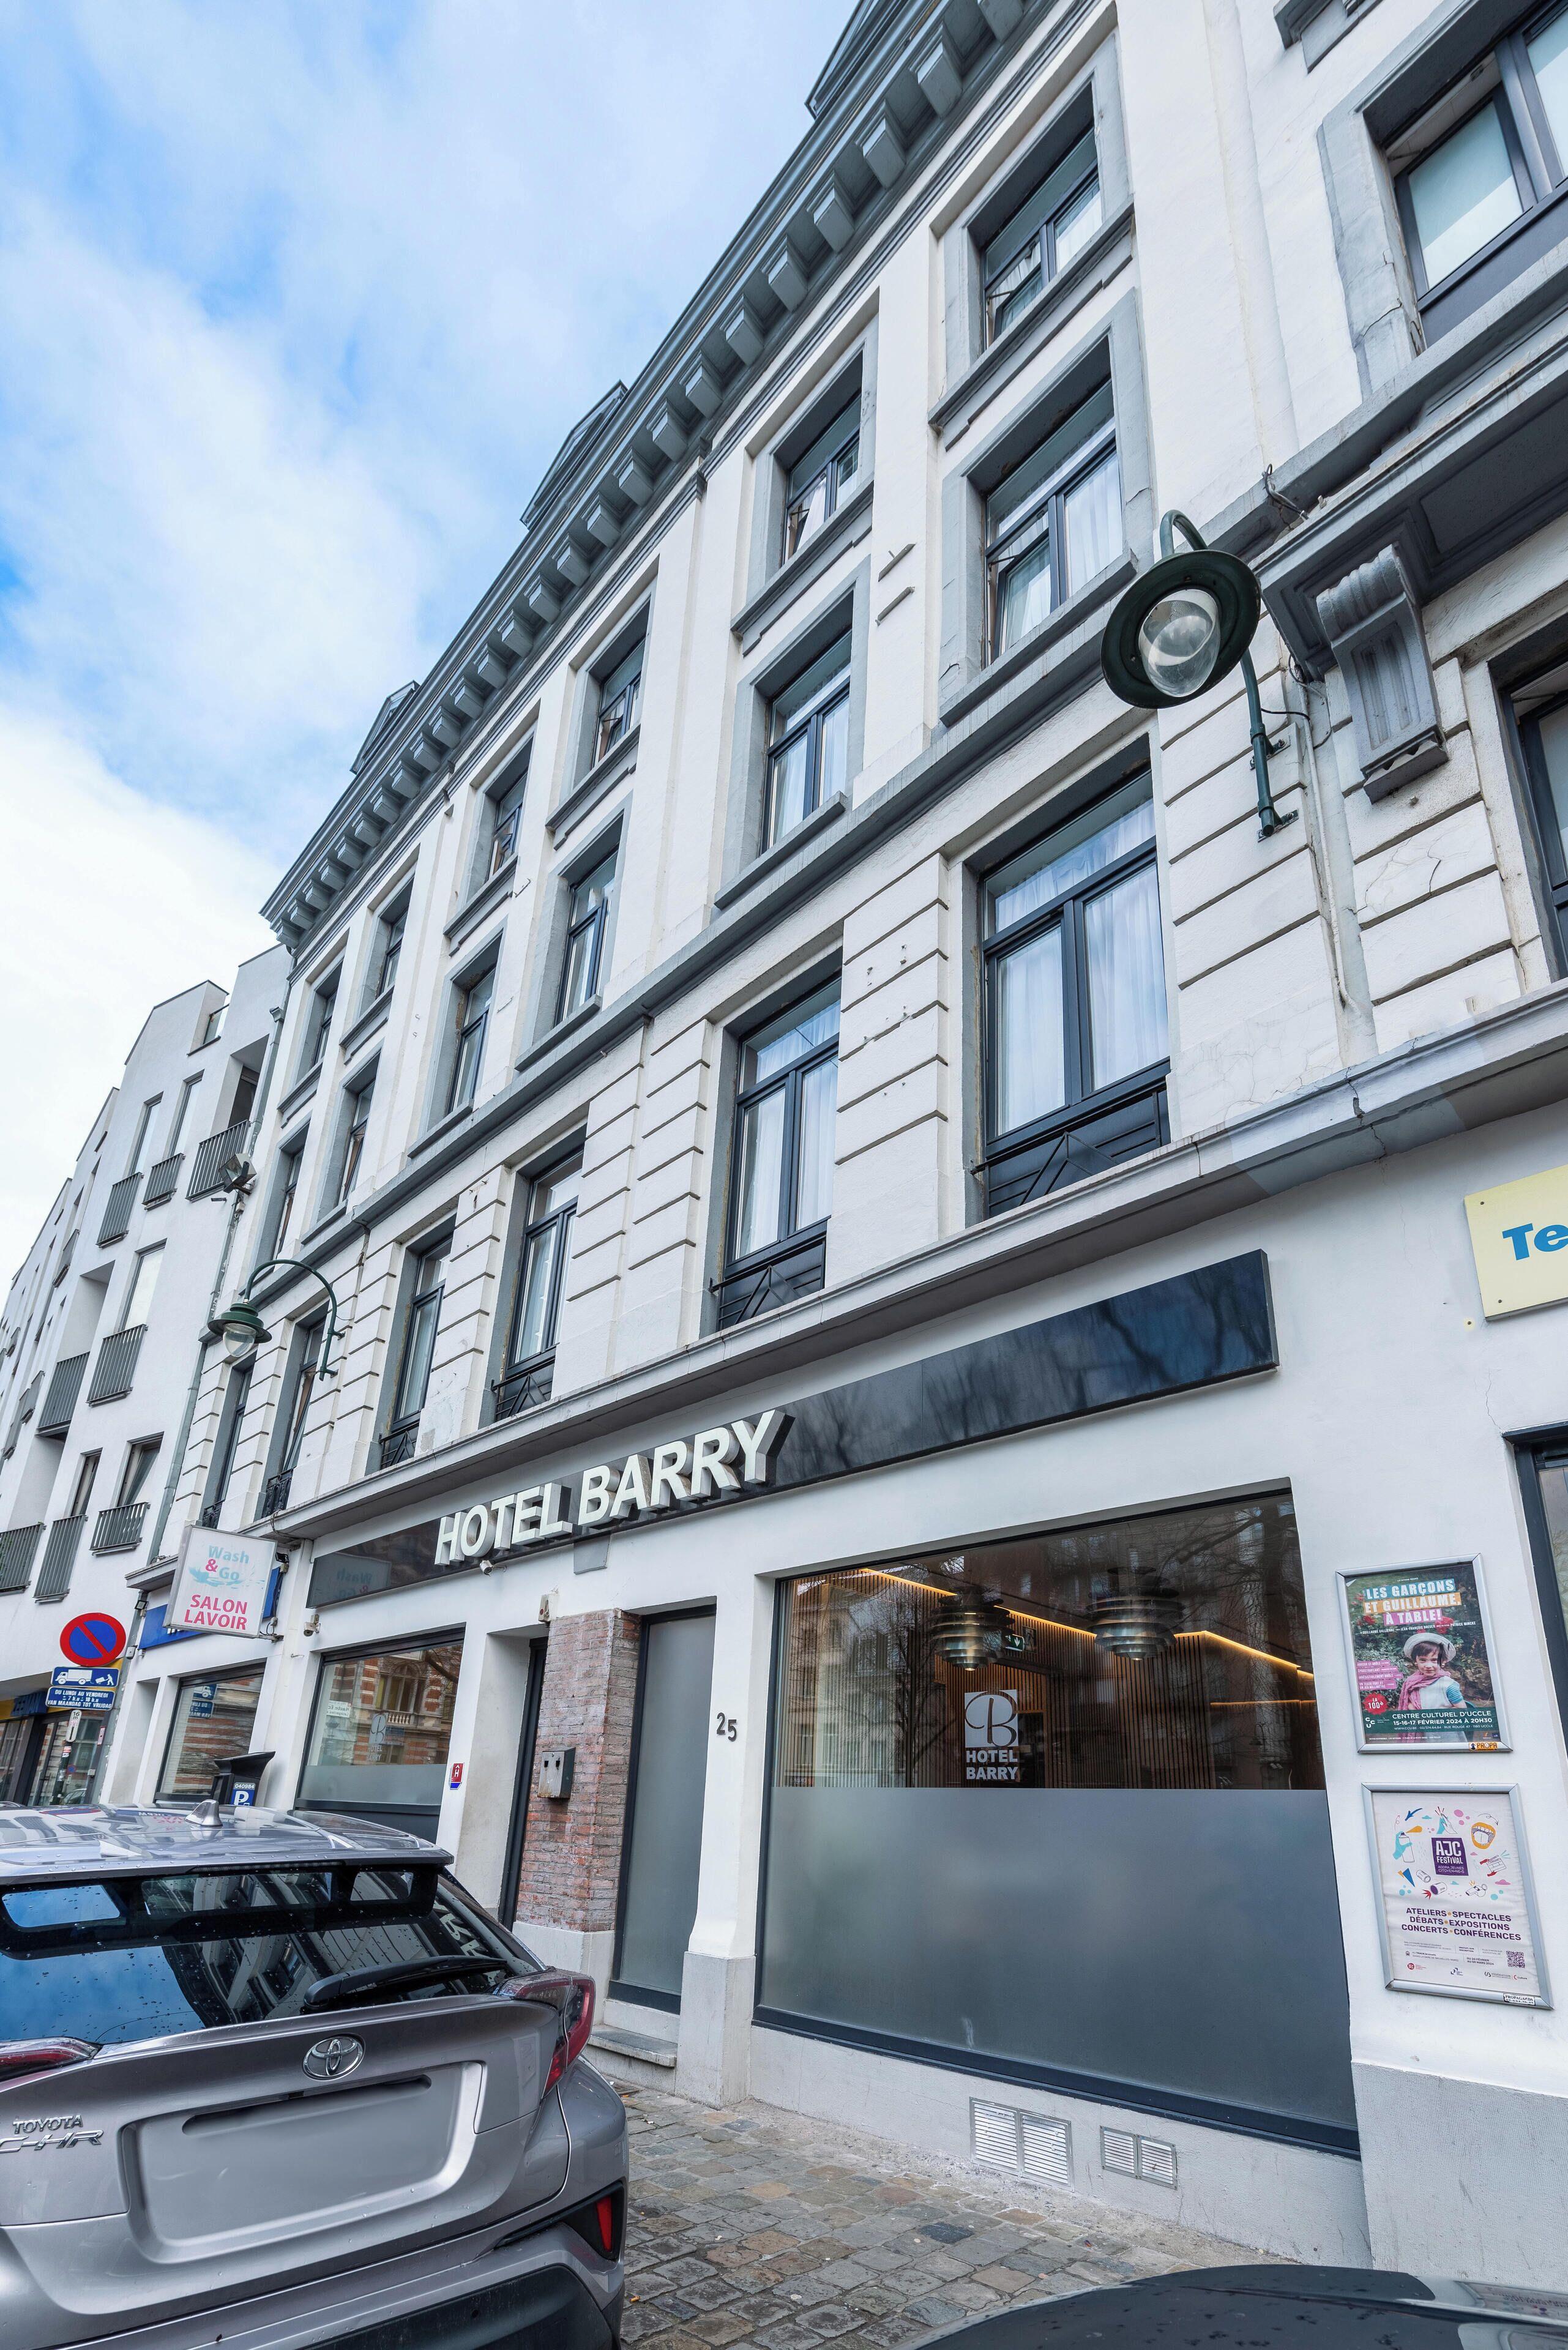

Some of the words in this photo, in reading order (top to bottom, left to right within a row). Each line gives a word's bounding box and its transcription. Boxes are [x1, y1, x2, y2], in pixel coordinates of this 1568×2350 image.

[435, 1482, 572, 1566] HOTEL
[578, 1409, 785, 1528] BARRY
[208, 1545, 249, 1564] Wash
[205, 1559, 218, 1573] &
[219, 1567, 239, 1581] Go
[1366, 1586, 1387, 1600] LES
[1391, 1580, 1455, 1595] GARÇONS
[190, 1594, 248, 1614] SALON
[1364, 1602, 1378, 1613] ET
[1383, 1593, 1461, 1611] GUILLAUME,
[184, 1609, 247, 1630] LAVOIR
[1386, 1611, 1394, 1625] À
[1397, 1609, 1442, 1624] TABLE!
[717, 1712, 737, 1742] 25
[966, 1750, 1018, 1762] HOTEL
[454, 1769, 460, 1778] H
[966, 1766, 1018, 1780] BARRY
[233, 1791, 249, 1805] P
[1436, 1840, 1462, 1857] AJC
[1436, 1856, 1463, 1865] FESTIVAL
[1406, 1908, 1447, 1917] ATELIERS
[1452, 1911, 1512, 1922] SPECTACLES
[1409, 1915, 1444, 1925] DÉBATS
[1449, 1919, 1510, 1931] EXPOSITIONS
[1402, 1924, 1449, 1934] CONCERTS
[1454, 1928, 1521, 1941] CONFÉRENCES
[13, 2114, 83, 2135] TOYOTA
